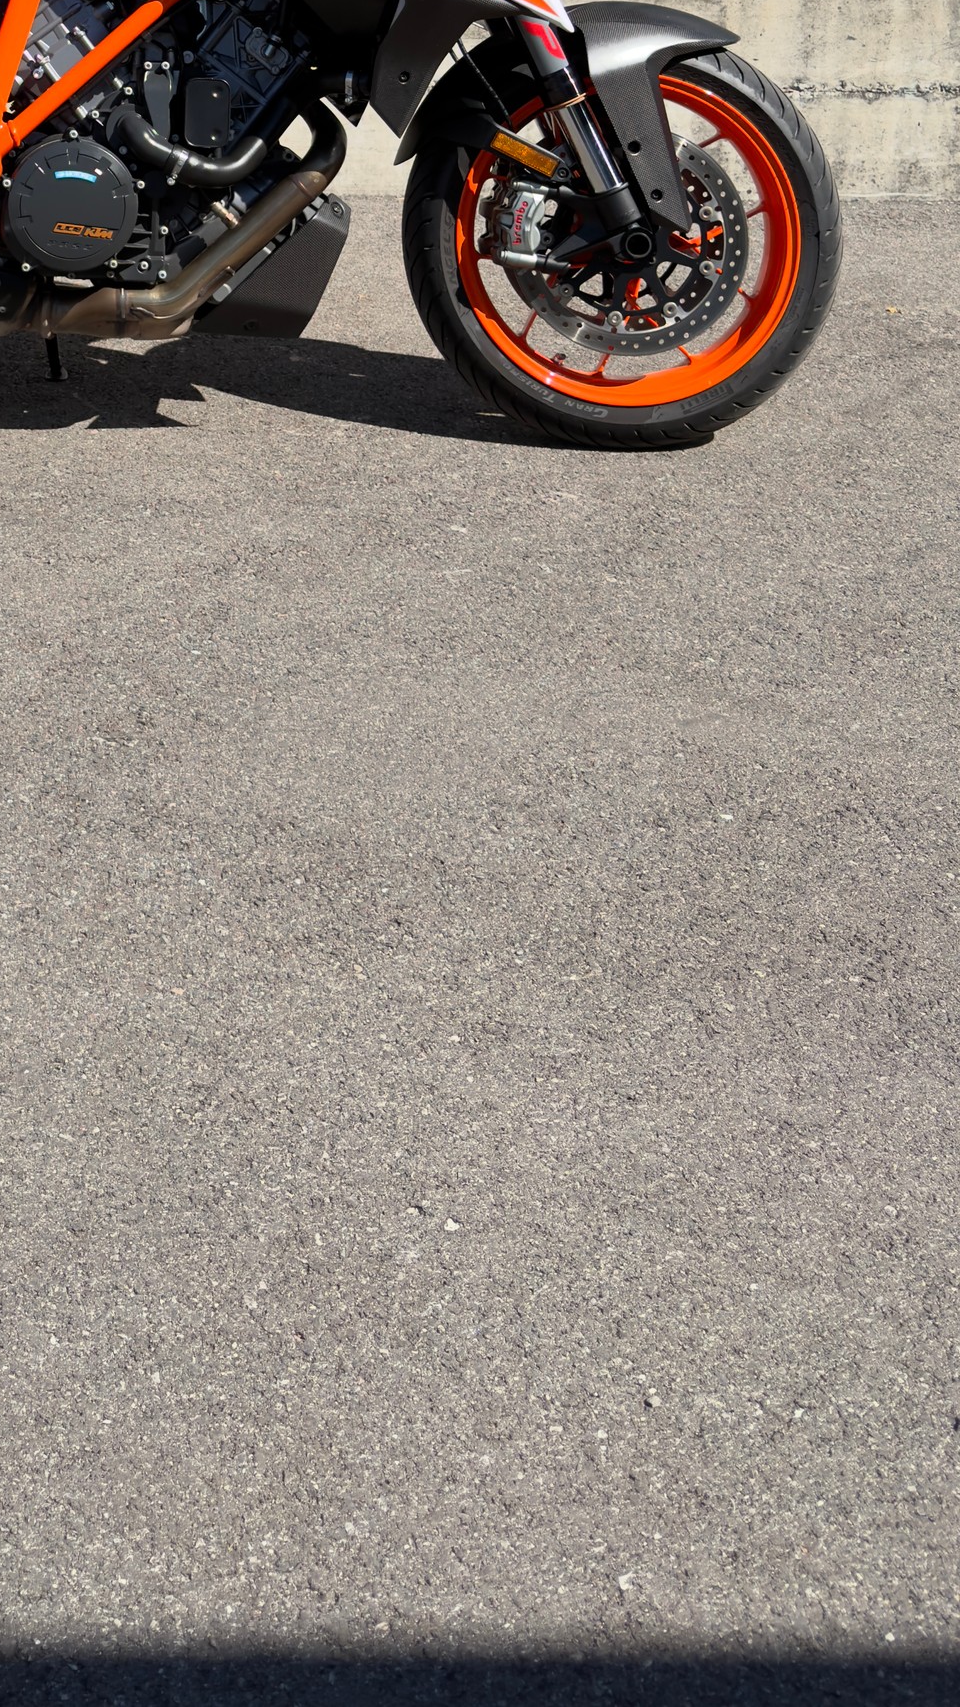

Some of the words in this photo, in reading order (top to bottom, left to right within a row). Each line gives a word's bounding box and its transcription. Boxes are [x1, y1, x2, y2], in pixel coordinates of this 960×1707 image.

[84, 226, 113, 239] KTM
[512, 201, 528, 246] brembo
[564, 400, 609, 419] GRAN
